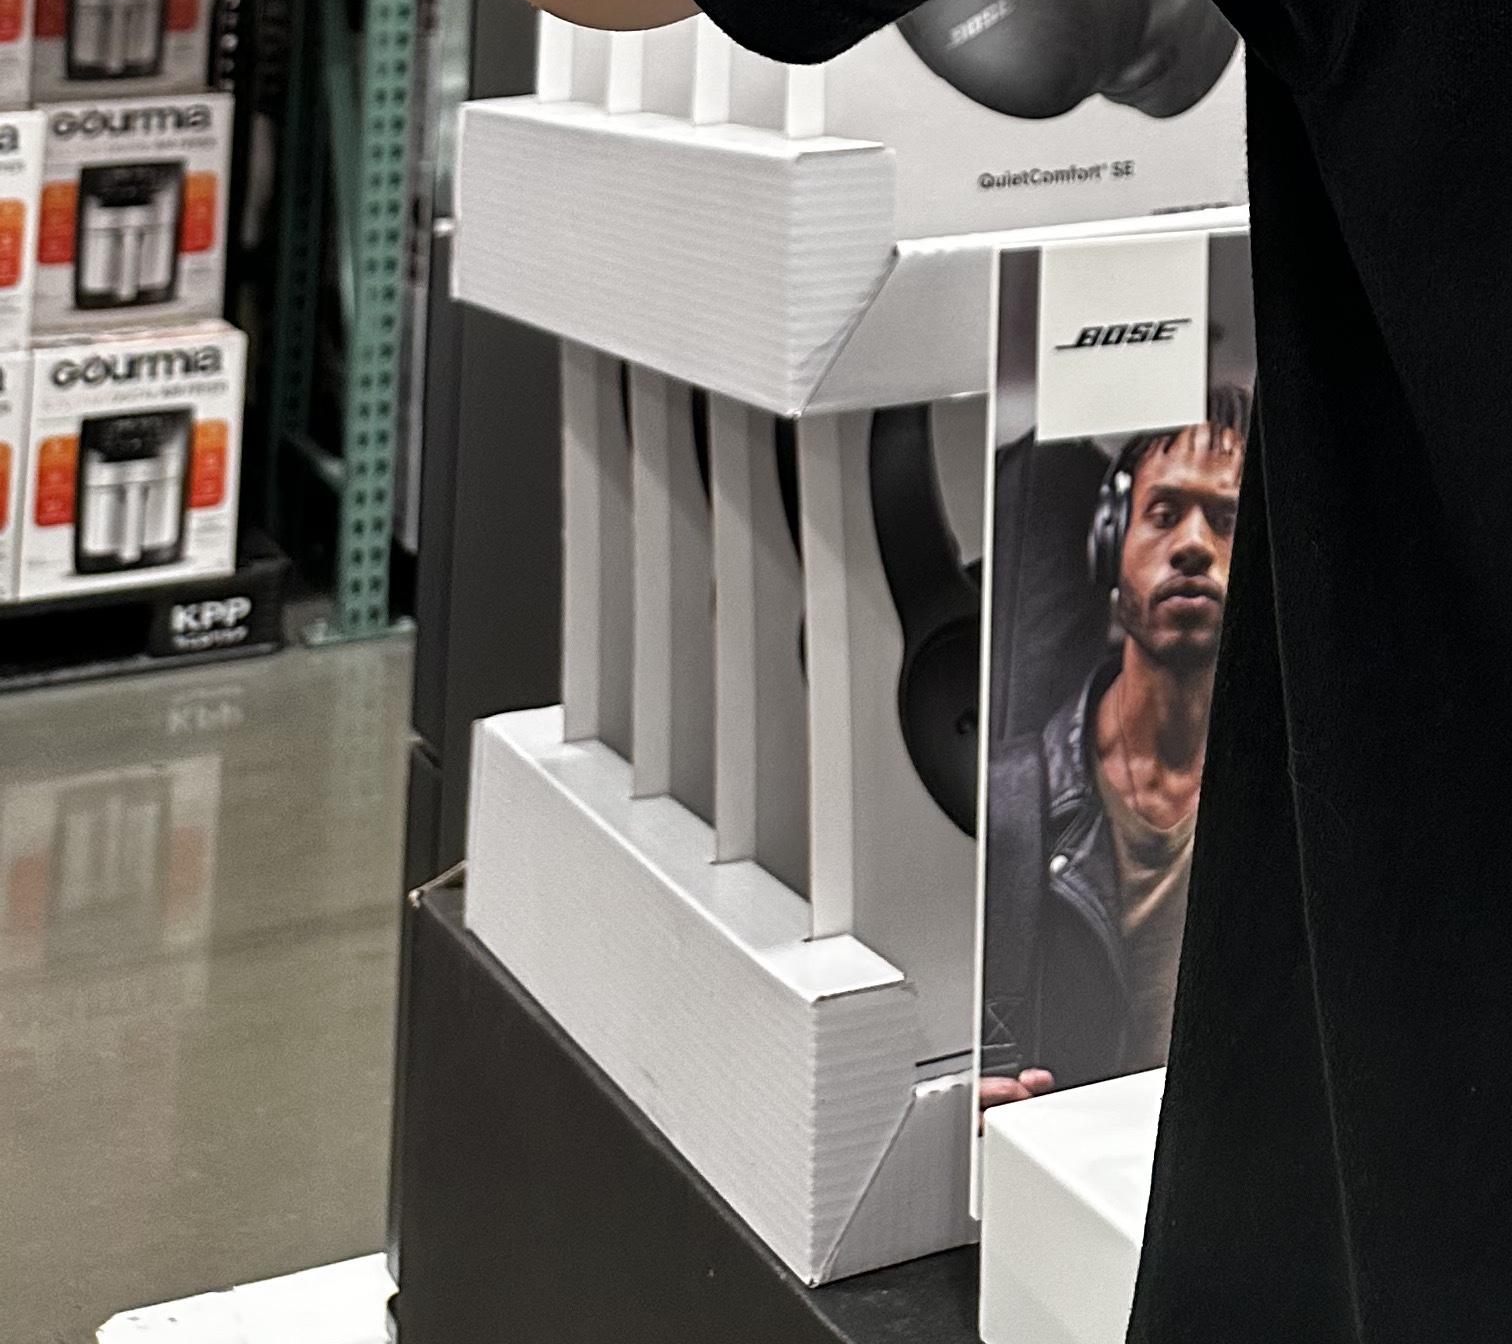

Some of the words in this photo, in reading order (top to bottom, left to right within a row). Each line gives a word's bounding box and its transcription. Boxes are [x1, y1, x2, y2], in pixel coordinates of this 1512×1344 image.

[1111, 159, 1135, 178] SE
[1055, 317, 1192, 349] BOSE
[172, 597, 252, 632] KPP
